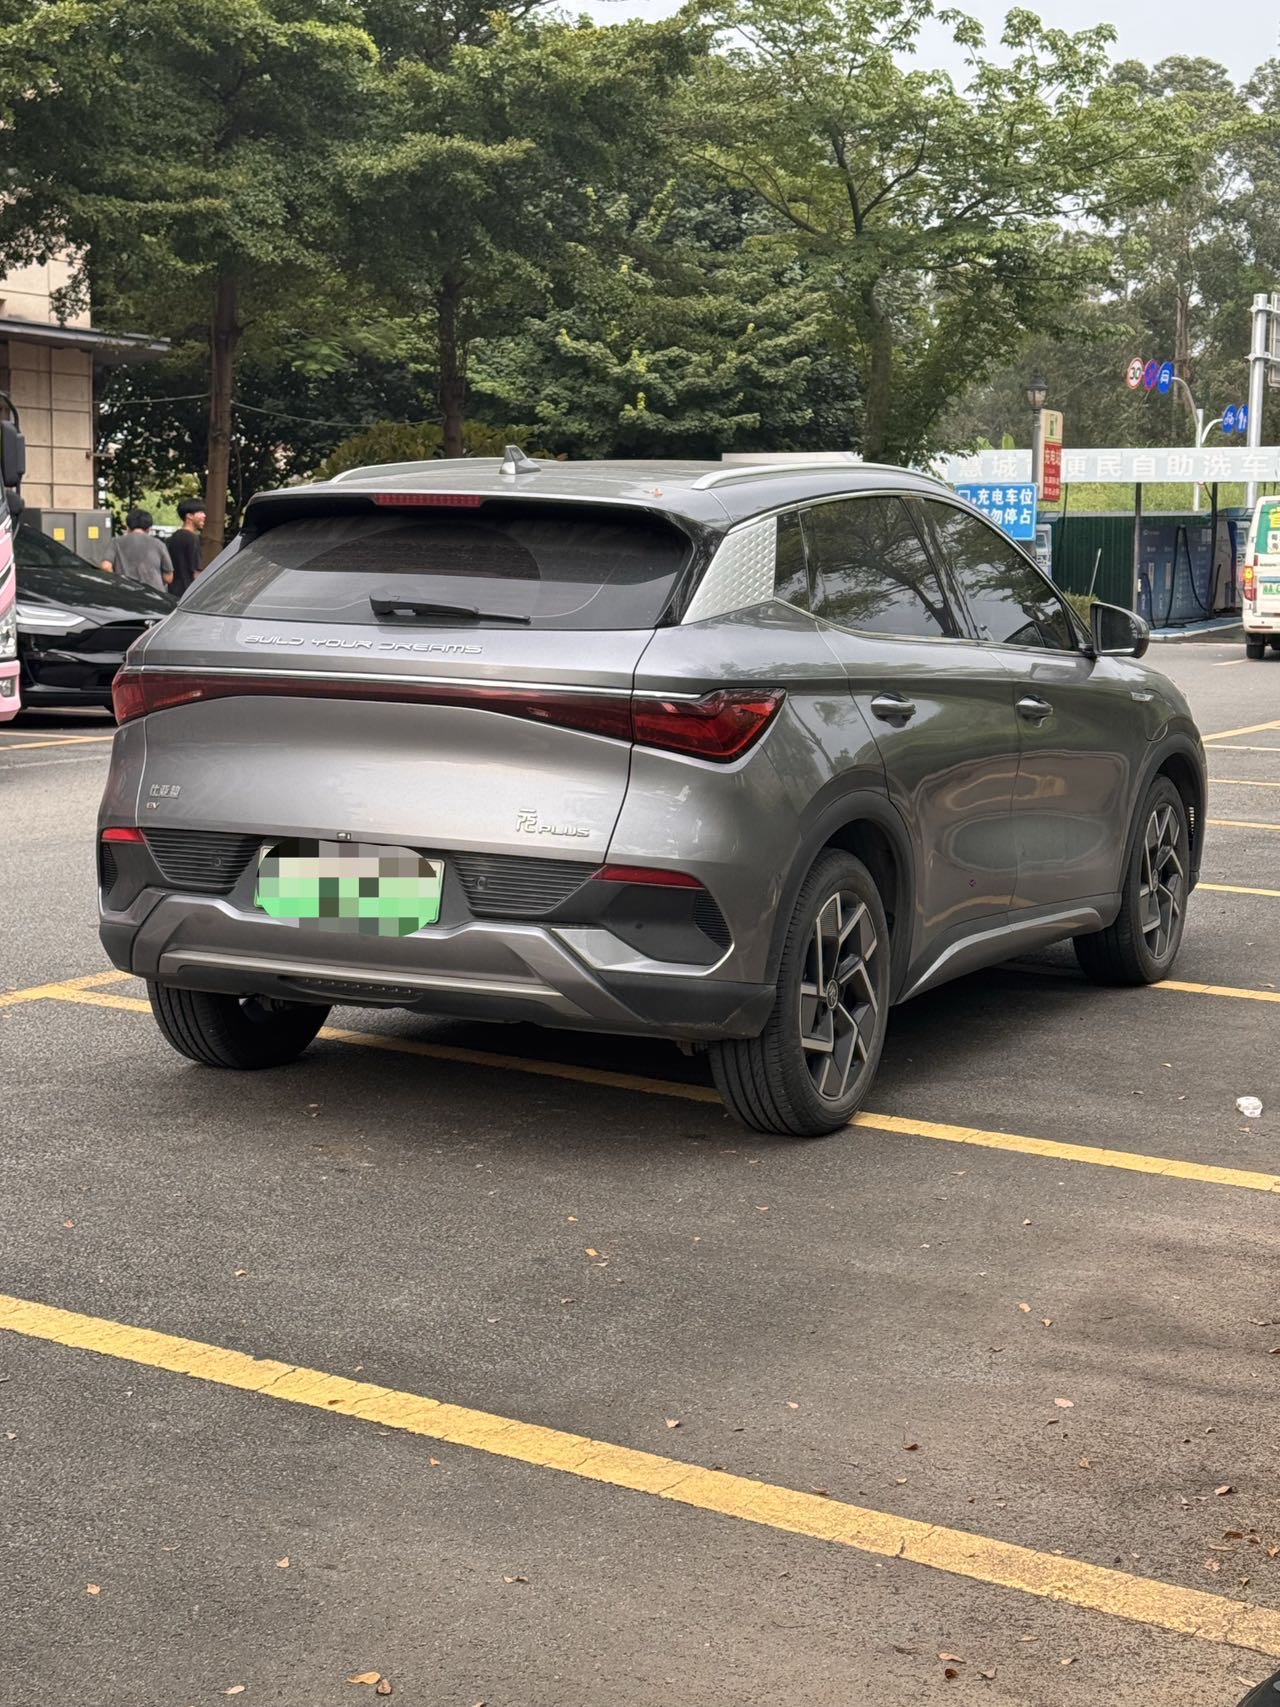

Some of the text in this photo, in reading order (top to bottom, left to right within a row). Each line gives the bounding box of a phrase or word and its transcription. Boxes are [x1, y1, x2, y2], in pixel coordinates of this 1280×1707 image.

[1130, 366, 1142, 380] 30
[244, 634, 483, 654] BUILD YOUR DREAMS
[146, 801, 160, 809] EV
